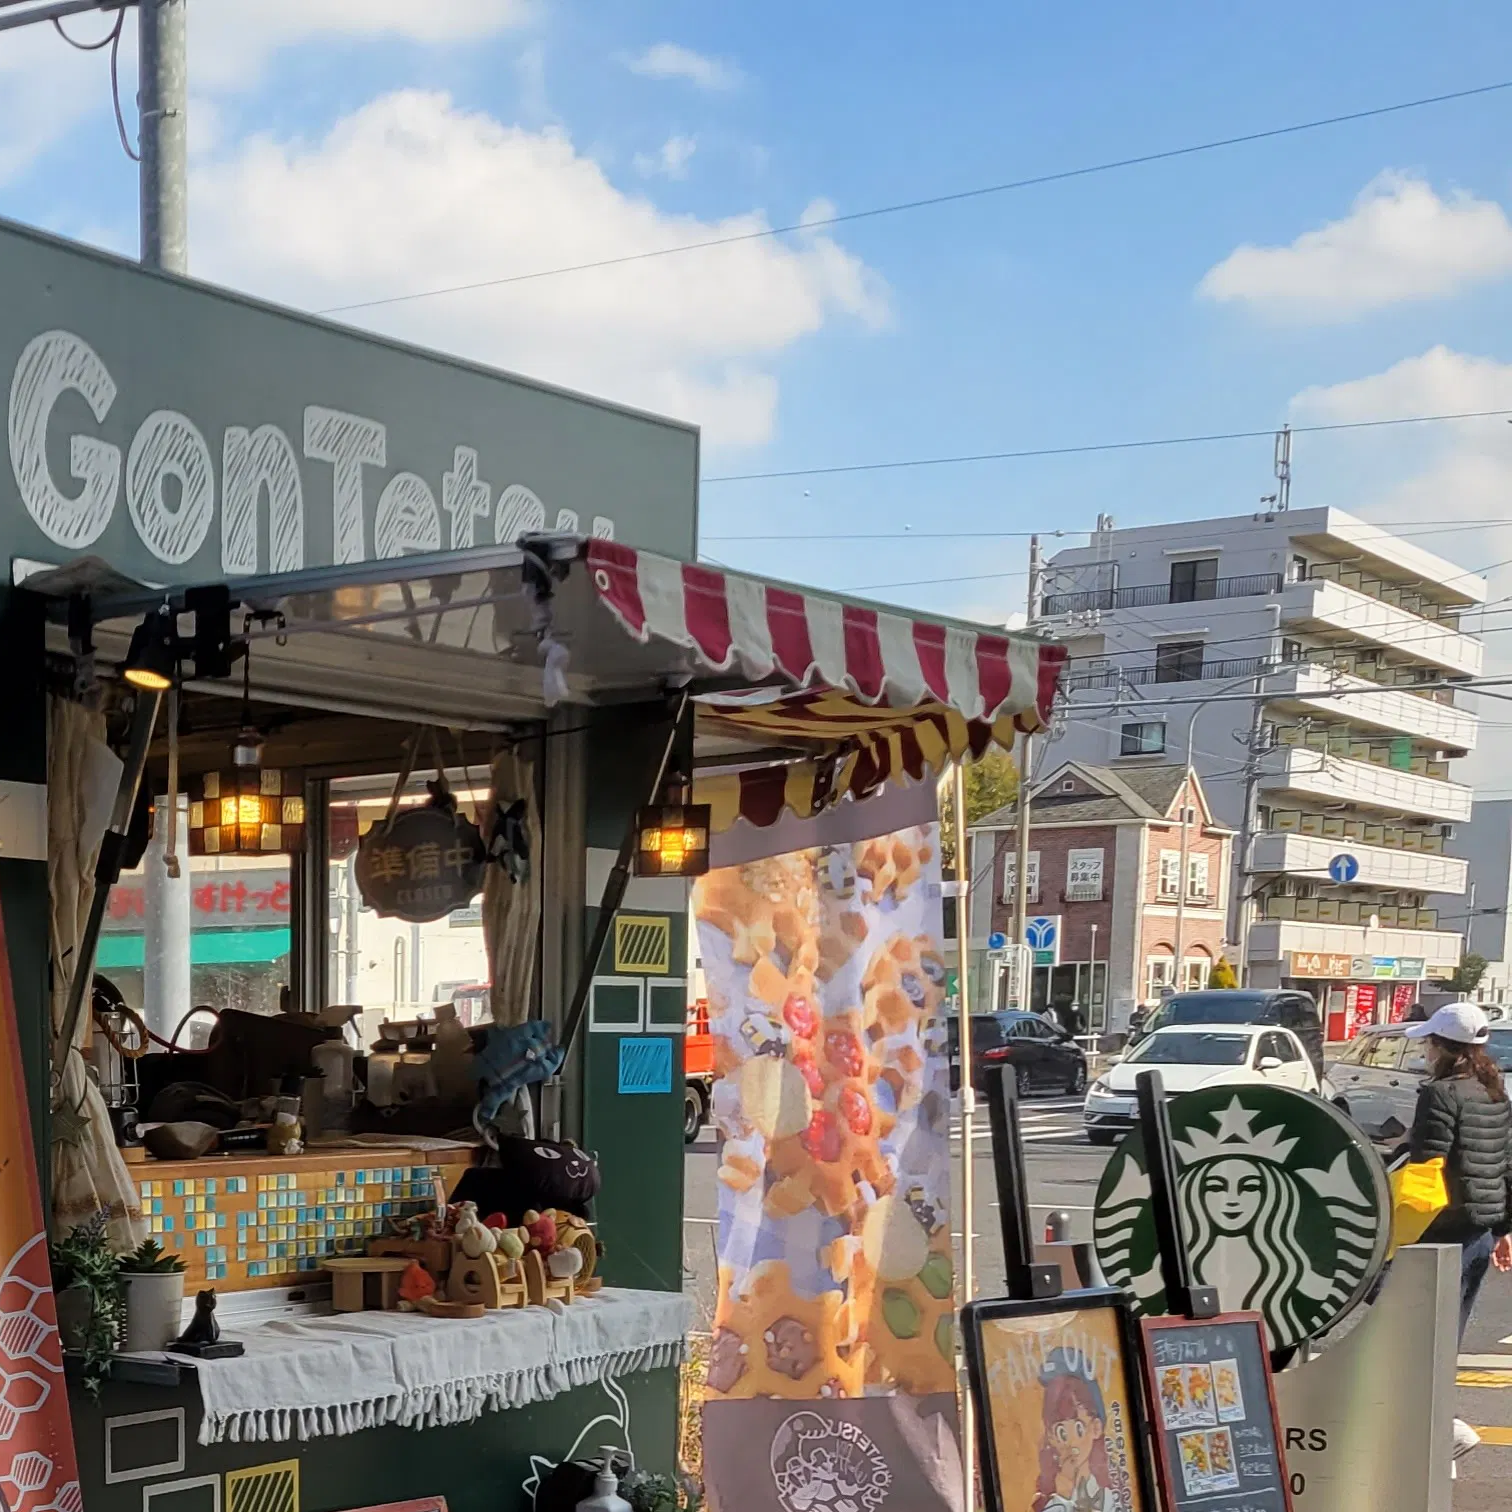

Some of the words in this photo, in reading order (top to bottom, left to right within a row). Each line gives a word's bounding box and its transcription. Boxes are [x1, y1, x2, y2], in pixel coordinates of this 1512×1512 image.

[1071, 861, 1101, 870] スタッフ
[1062, 1327, 1118, 1393] OUT
